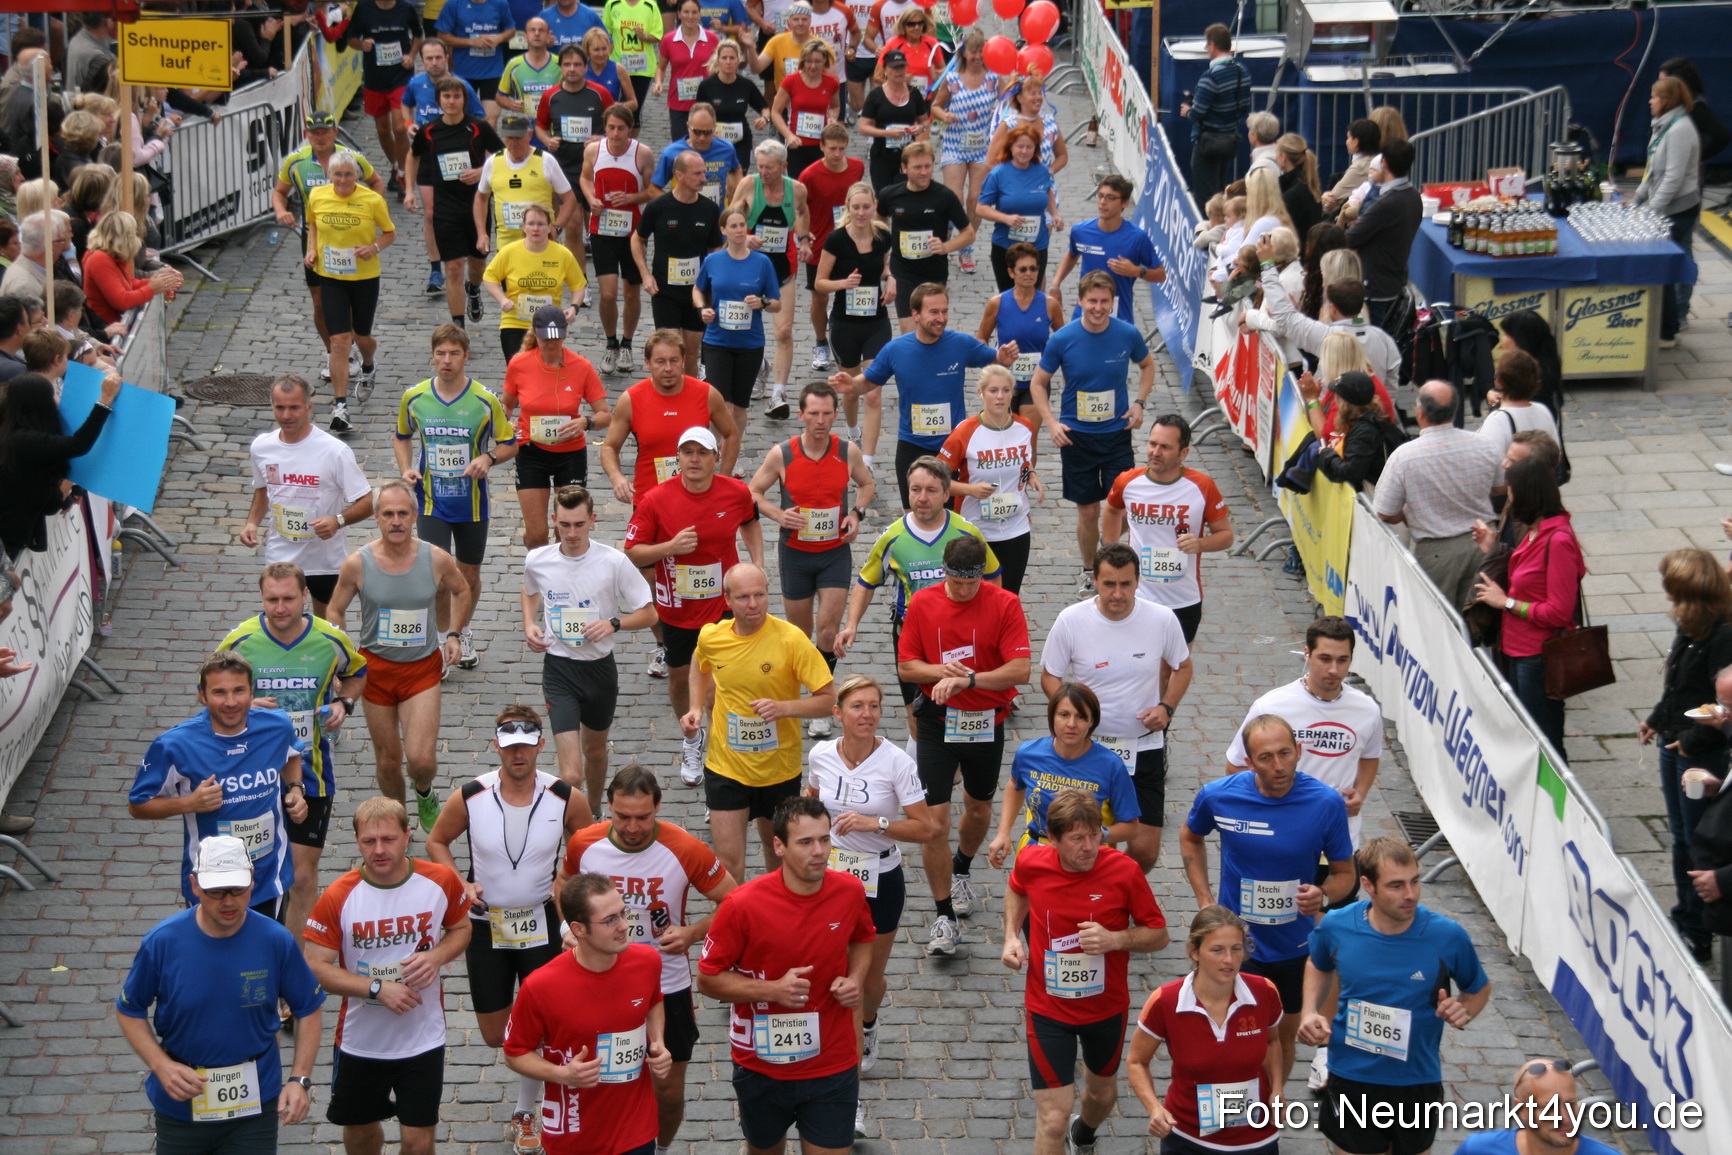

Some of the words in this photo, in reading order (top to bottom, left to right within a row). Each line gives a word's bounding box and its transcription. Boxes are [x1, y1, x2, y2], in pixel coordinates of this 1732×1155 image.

[128, 32, 224, 53] Schnupper-
[383, 50, 401, 60] 2050
[160, 54, 191, 69] lauf
[570, 126, 589, 134] 3080
[804, 122, 821, 131] 3096
[448, 162, 468, 171] 2728
[511, 211, 525, 220] 358
[608, 219, 628, 228] 2579
[1018, 225, 1037, 233] 2337
[764, 236, 784, 244] 2467
[911, 242, 928, 251] 615
[332, 257, 351, 266] 3581
[680, 268, 696, 277] 601
[856, 297, 875, 306] 2676
[728, 311, 749, 320] 2336
[1564, 289, 1646, 331] Glossner
[1605, 311, 1643, 328] Bier
[1015, 363, 1037, 372] 2217
[921, 407, 938, 416] Holger
[1091, 403, 1109, 413] 262
[926, 415, 945, 425] 263
[424, 426, 471, 438] BOCK
[545, 428, 558, 438] 81
[438, 447, 462, 456] Wolfgang
[977, 445, 1028, 463] MERZ
[439, 456, 465, 467] 3166
[976, 456, 1021, 470] Reisen
[283, 473, 320, 486] HAARE
[282, 508, 304, 518] Egmont
[811, 511, 829, 519] Stefan
[994, 505, 1018, 515] 2877
[1130, 502, 1190, 519] MERZ
[1131, 512, 1176, 526] Reisen
[287, 520, 308, 532] 534
[814, 520, 834, 531] 483
[1153, 551, 1169, 559] Josef
[688, 568, 706, 576] Erwin
[1154, 561, 1182, 572] 2854
[909, 567, 945, 581] BOC
[693, 577, 715, 588] 856
[393, 623, 422, 634] 3826
[950, 650, 966, 659] DEHN
[256, 677, 319, 690] BOCK
[960, 710, 983, 718] Thomas
[961, 719, 989, 731] 2585
[741, 728, 771, 741] 2633
[1100, 736, 1117, 744] Adolf
[1314, 739, 1350, 751] JANIG
[201, 768, 278, 792] YSCAD
[1030, 769, 1039, 780] 10.
[1040, 774, 1100, 792] NEUMARKTER
[234, 821, 260, 833] Robert
[838, 852, 859, 865] Birgit
[612, 876, 664, 896] ERZ
[1257, 884, 1280, 893] Atschi
[1257, 897, 1293, 910] 3393
[504, 909, 534, 919] Stephan
[306, 918, 328, 933] MERZ
[352, 911, 433, 940] MERZ
[511, 919, 538, 935] 149
[352, 932, 417, 950] Reisen
[1061, 937, 1079, 947] DEHN
[1060, 958, 1081, 966] Franz
[372, 967, 397, 976] Stefan
[1062, 970, 1098, 983] 2587
[1363, 1006, 1390, 1021] Florian
[771, 1018, 808, 1029] Christian
[1363, 1021, 1401, 1042] 3665
[615, 1037, 630, 1047] Tino
[774, 1032, 813, 1047] 2413
[615, 1045, 644, 1065] 3555
[210, 1071, 241, 1083] Jürgen
[217, 1084, 249, 1102] 603
[568, 1093, 580, 1133] MAX
